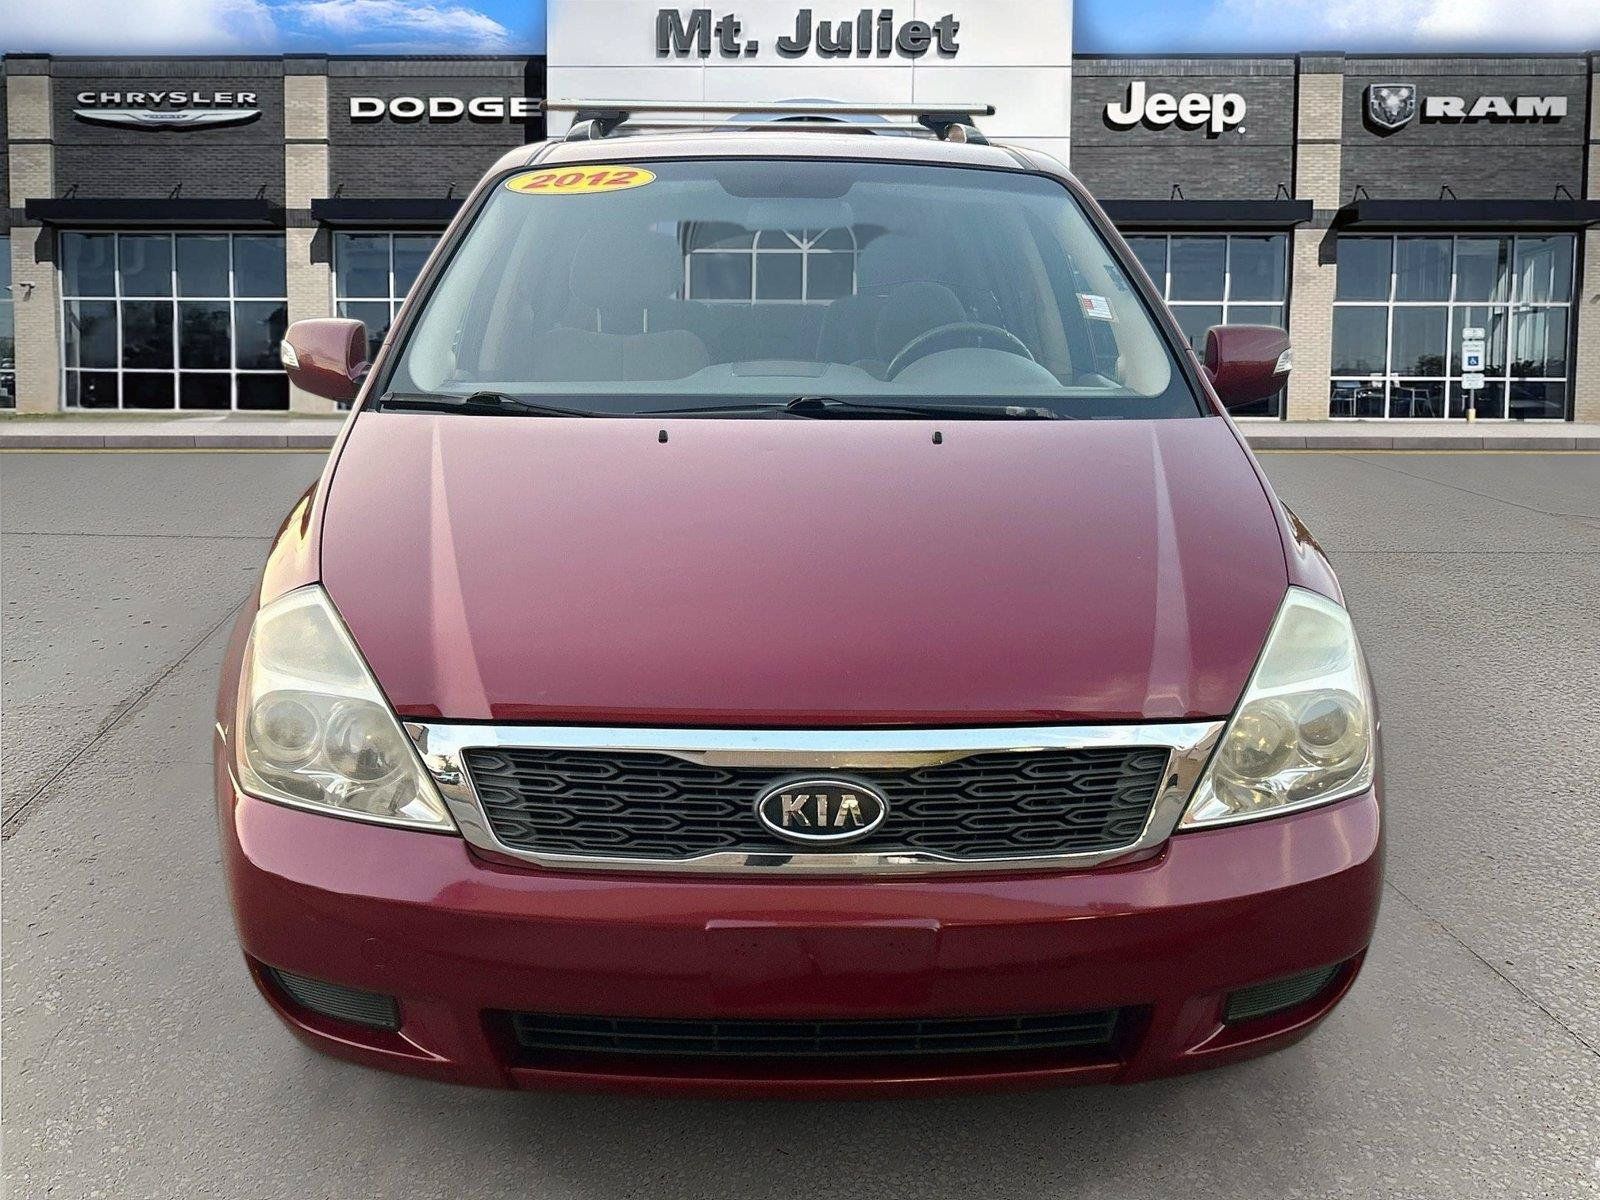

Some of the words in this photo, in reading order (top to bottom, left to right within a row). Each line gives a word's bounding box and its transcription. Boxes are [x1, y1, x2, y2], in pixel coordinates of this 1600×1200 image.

[656, 9, 758, 57] Mt.
[776, 9, 959, 58] Juliet
[76, 92, 257, 104] CHRYSLER
[350, 97, 543, 117] DODGE
[1425, 96, 1568, 116] RAM
[522, 171, 639, 189] 2012
[780, 795, 865, 826] KIA
